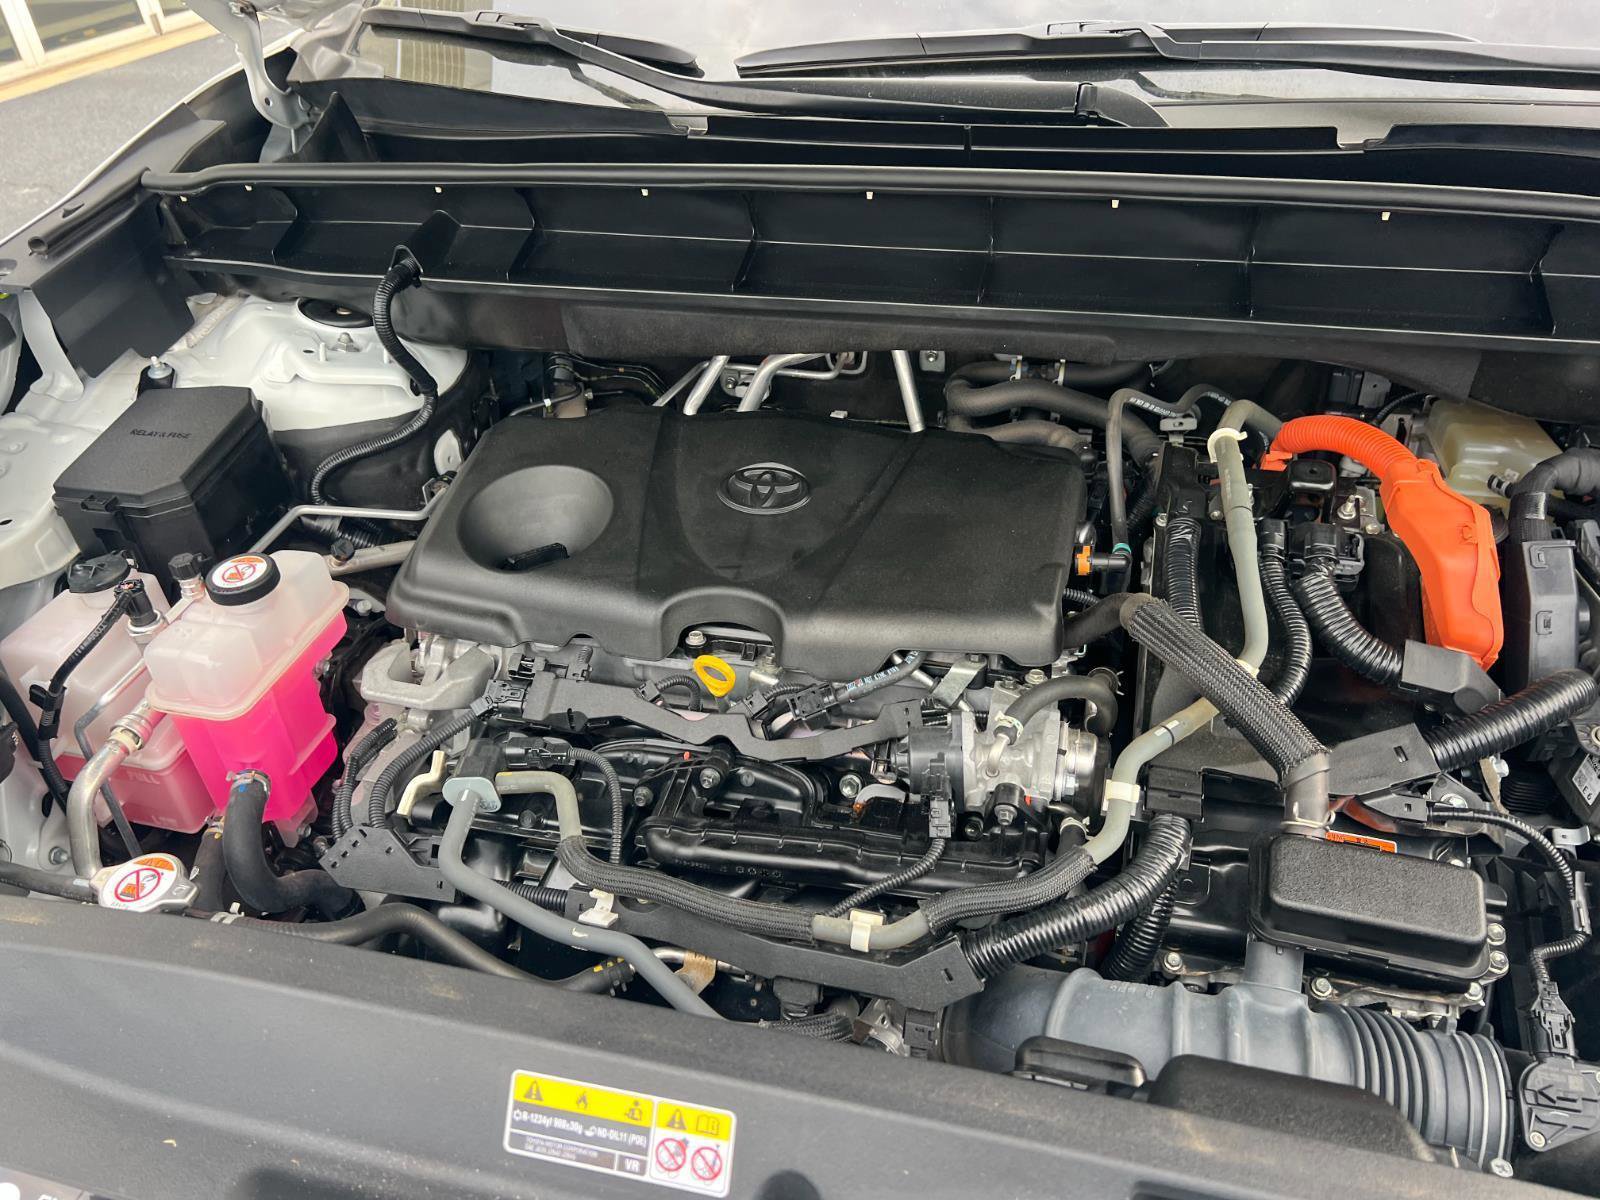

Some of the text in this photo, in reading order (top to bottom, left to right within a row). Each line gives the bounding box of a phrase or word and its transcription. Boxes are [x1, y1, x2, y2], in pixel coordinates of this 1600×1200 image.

[130, 428, 157, 438] RELAY
[166, 431, 192, 439] FUSE
[624, 1157, 640, 1173] VR
